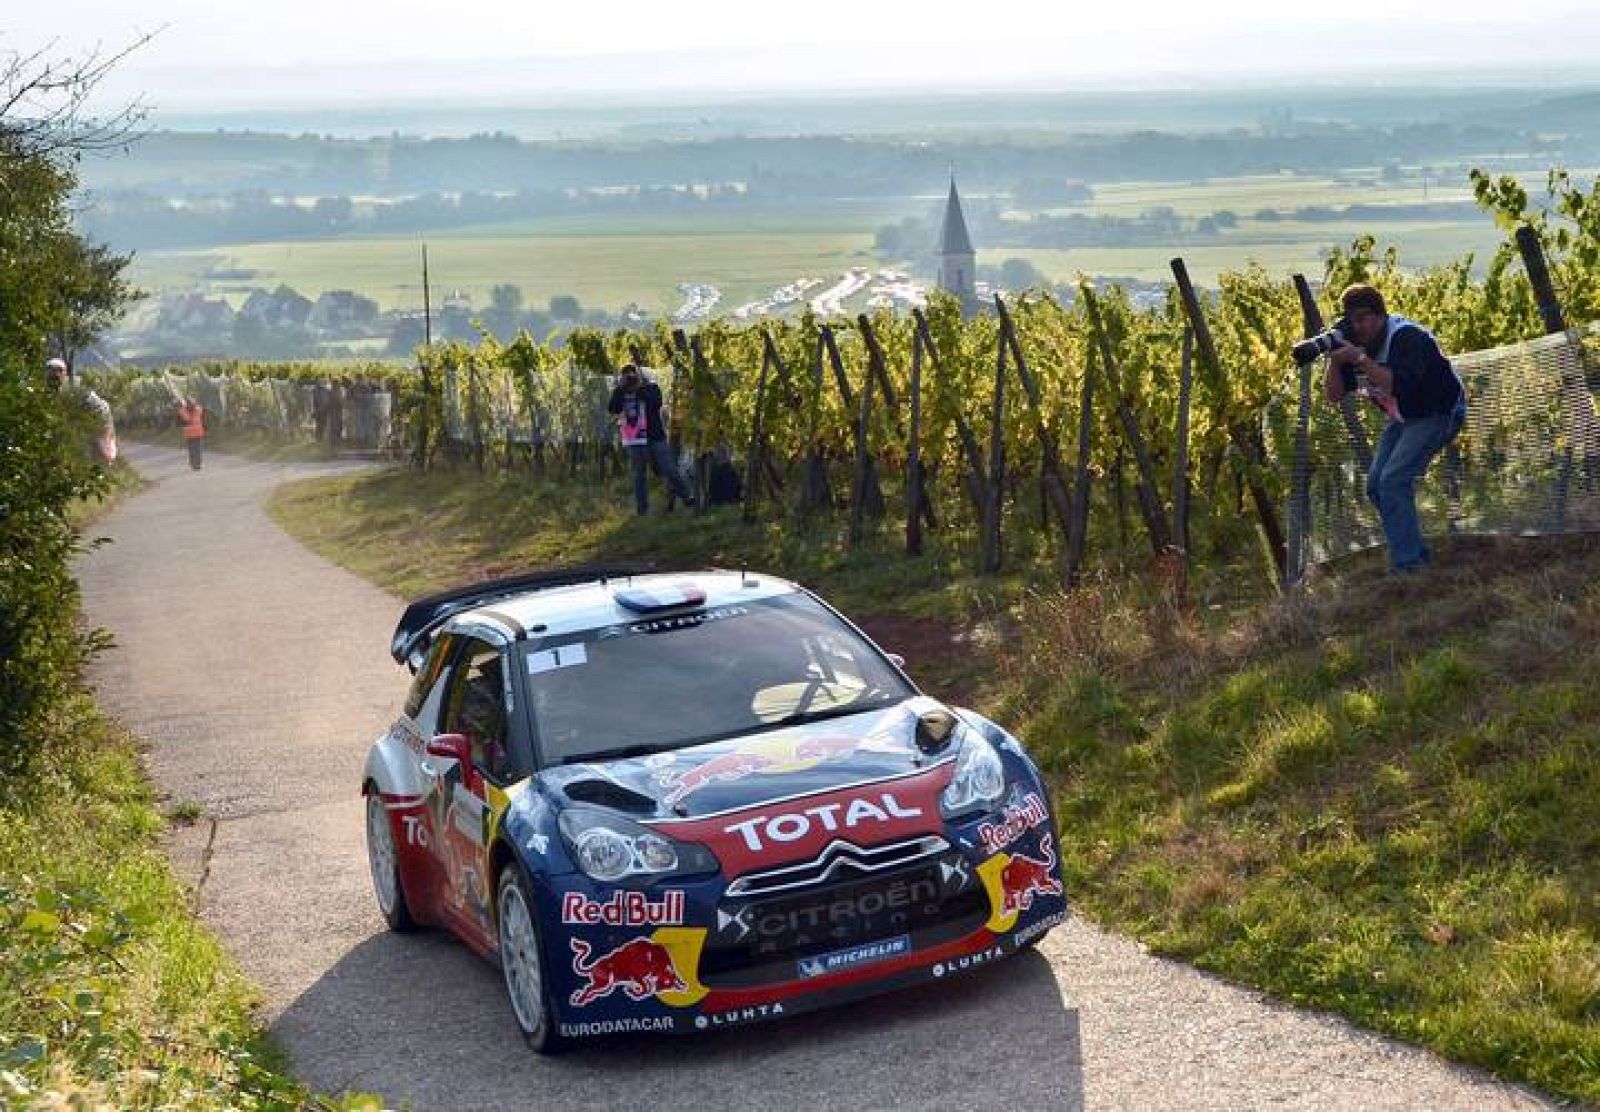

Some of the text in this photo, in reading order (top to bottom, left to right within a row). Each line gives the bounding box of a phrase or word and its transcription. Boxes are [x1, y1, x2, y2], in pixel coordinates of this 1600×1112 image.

[550, 649, 561, 666] 1
[724, 793, 922, 851] TOTAL
[562, 890, 685, 926] Red Bull
[827, 940, 906, 966] MICHELIN
[948, 946, 1004, 971] LUHTA
[712, 1002, 784, 1024] LUHTA
[560, 1016, 675, 1037] EURODATACAR
